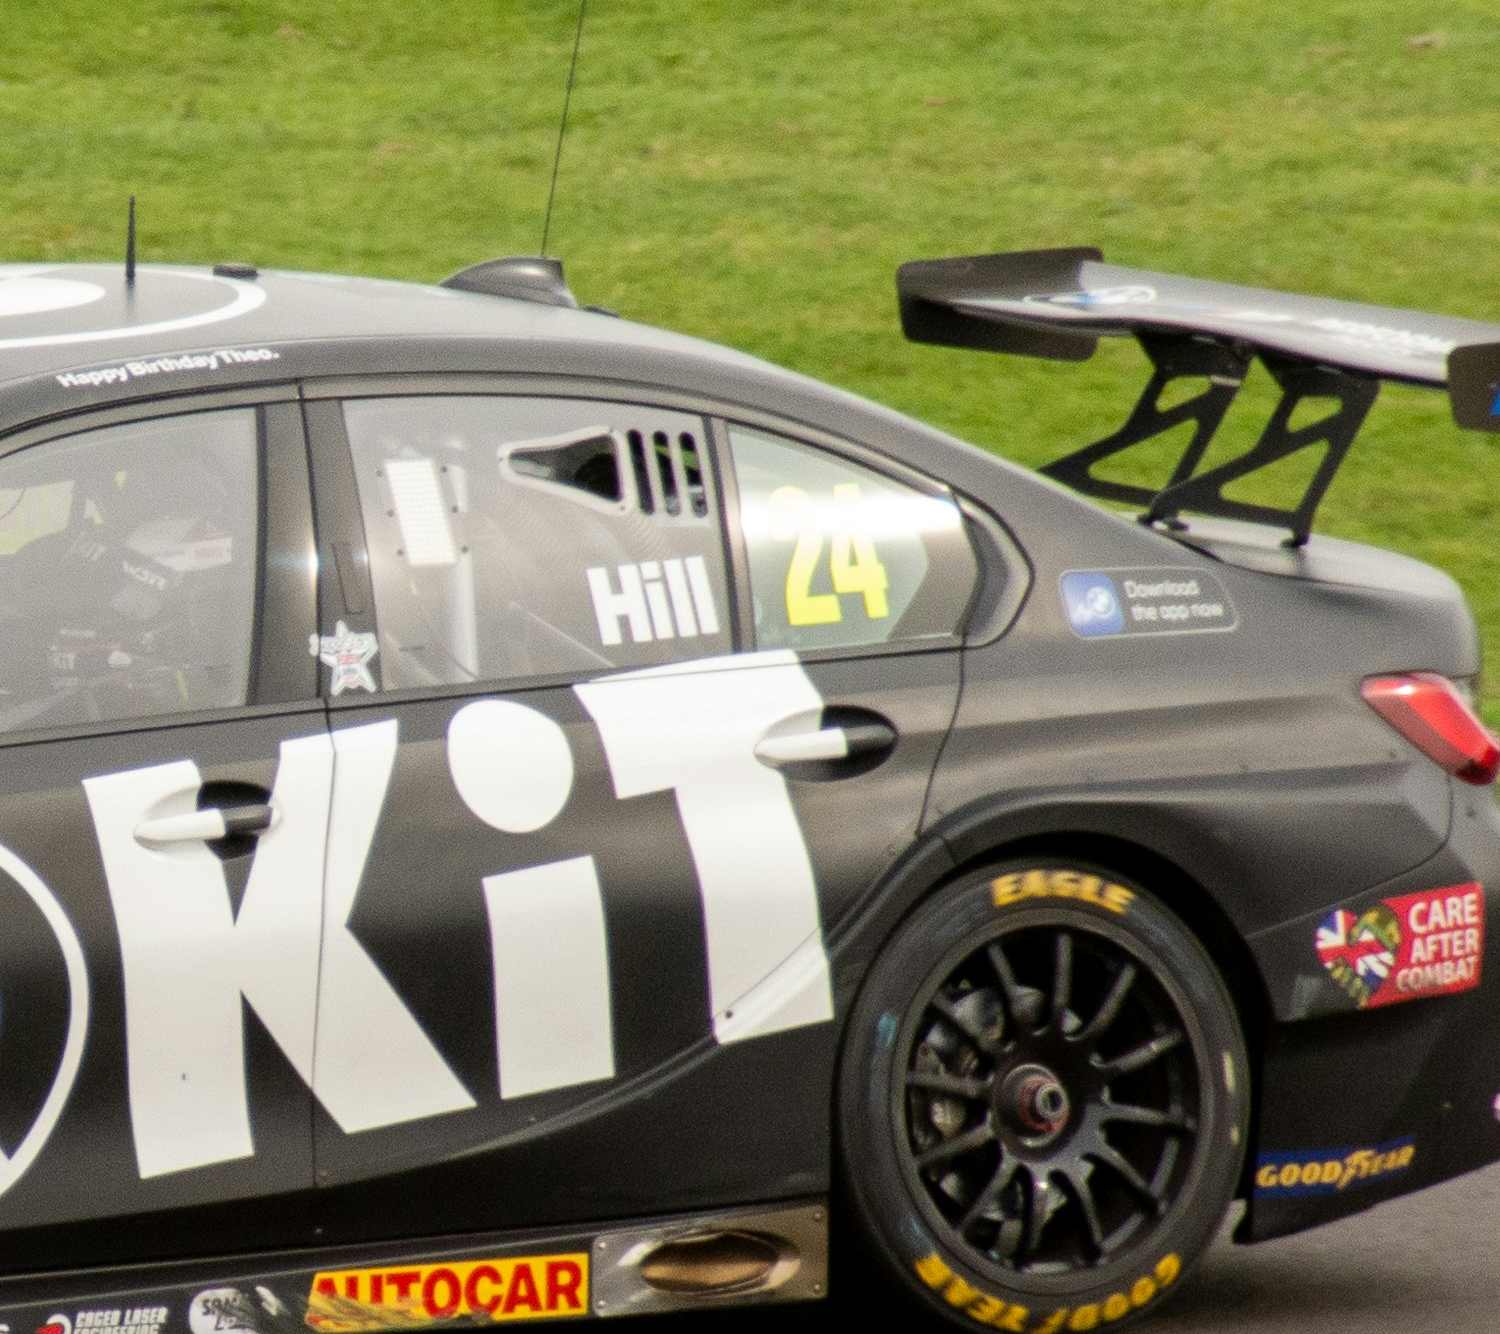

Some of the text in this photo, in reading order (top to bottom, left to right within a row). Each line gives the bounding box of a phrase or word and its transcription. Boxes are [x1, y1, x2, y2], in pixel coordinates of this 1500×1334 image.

[56, 348, 280, 387] Happy Birthday Theo.
[769, 483, 889, 626] 24
[586, 554, 720, 646] Hill
[1123, 580, 1200, 599] Download
[1131, 604, 1225, 622] the app now
[991, 869, 1138, 915] EAGLE
[1408, 893, 1478, 933] CARE
[1410, 928, 1479, 964] AFTER
[1395, 956, 1479, 992] COMBAT
[124, 1307, 168, 1326] LASER
